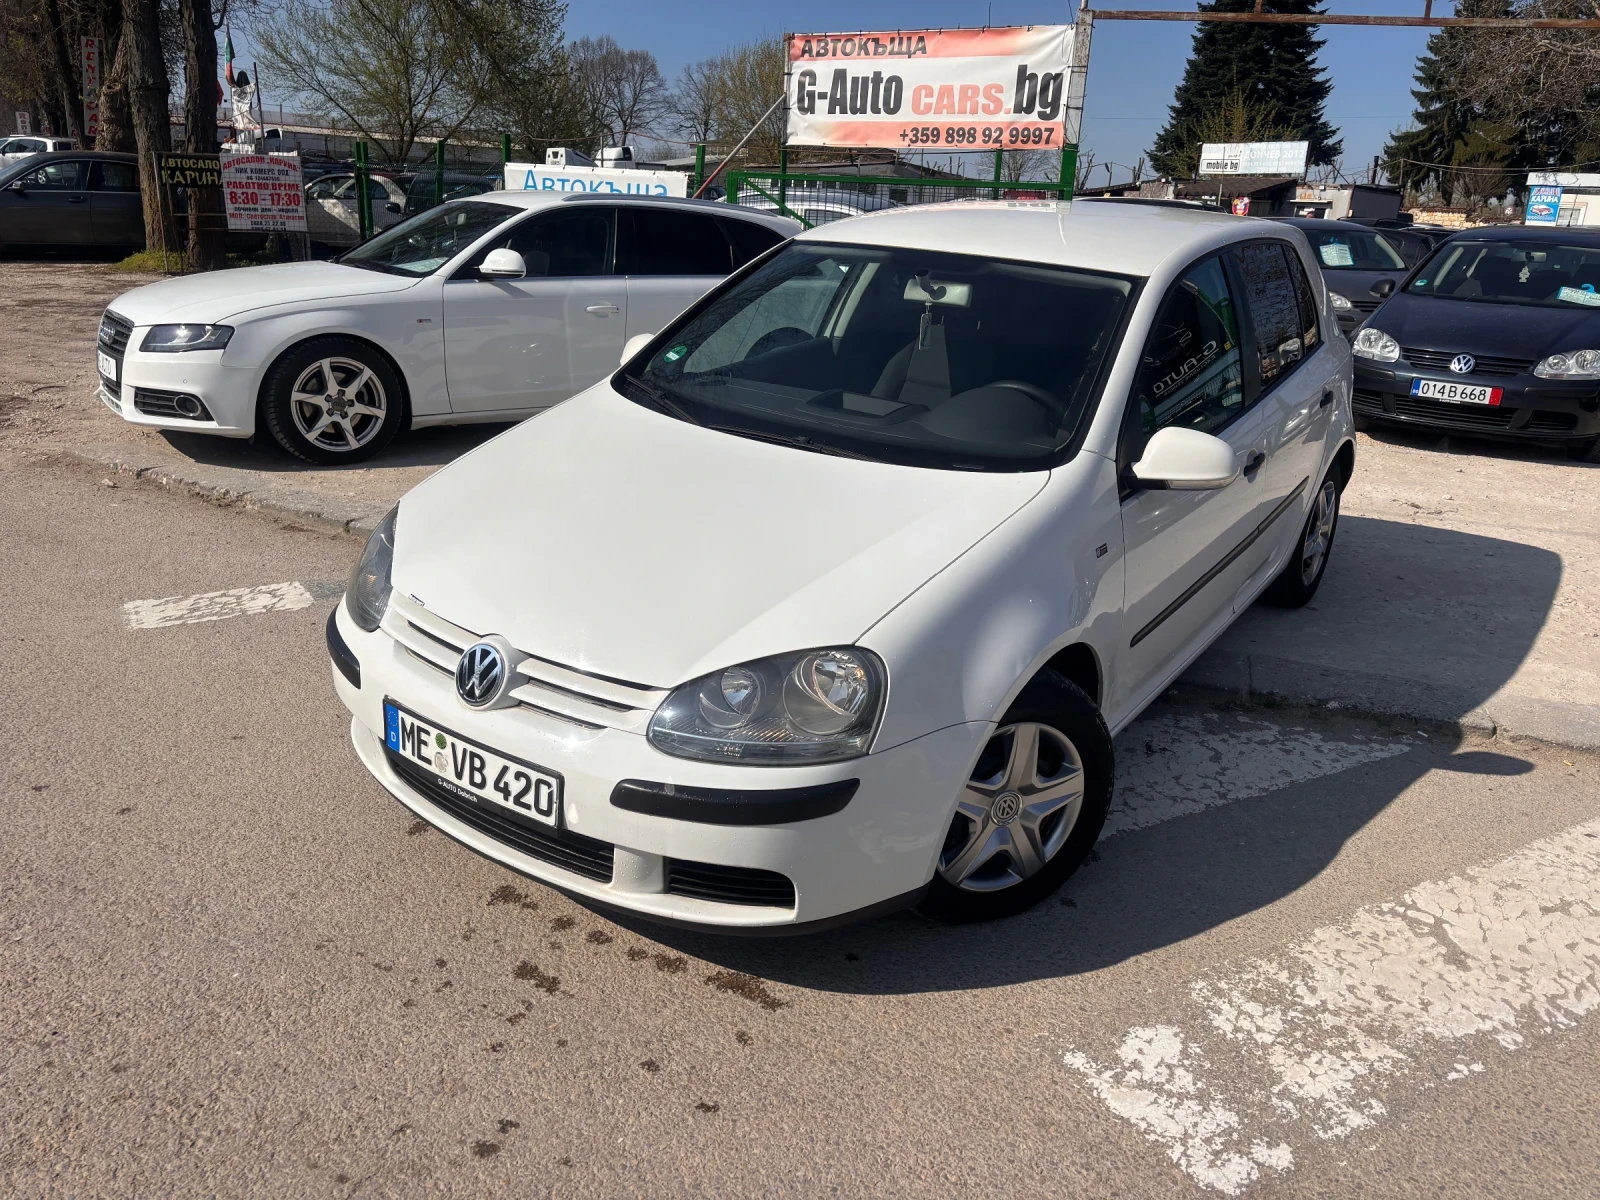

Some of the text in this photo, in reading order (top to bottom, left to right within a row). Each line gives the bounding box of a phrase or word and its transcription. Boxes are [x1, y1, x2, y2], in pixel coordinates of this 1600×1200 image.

[800, 35, 927, 59] АВТОКЪЩА
[797, 67, 904, 116] G-Auto
[899, 127, 1055, 146] +359 898 92 9997
[161, 158, 219, 169] АВТОСАЛО
[250, 168, 275, 176] КОМЕРС
[226, 181, 300, 191] РАБОТНО ВРЕМЕ
[229, 191, 258, 205] 8:30
[269, 192, 300, 207] 17:30
[401, 716, 432, 766] ME
[450, 742, 487, 790] VB
[493, 765, 554, 817] 420
